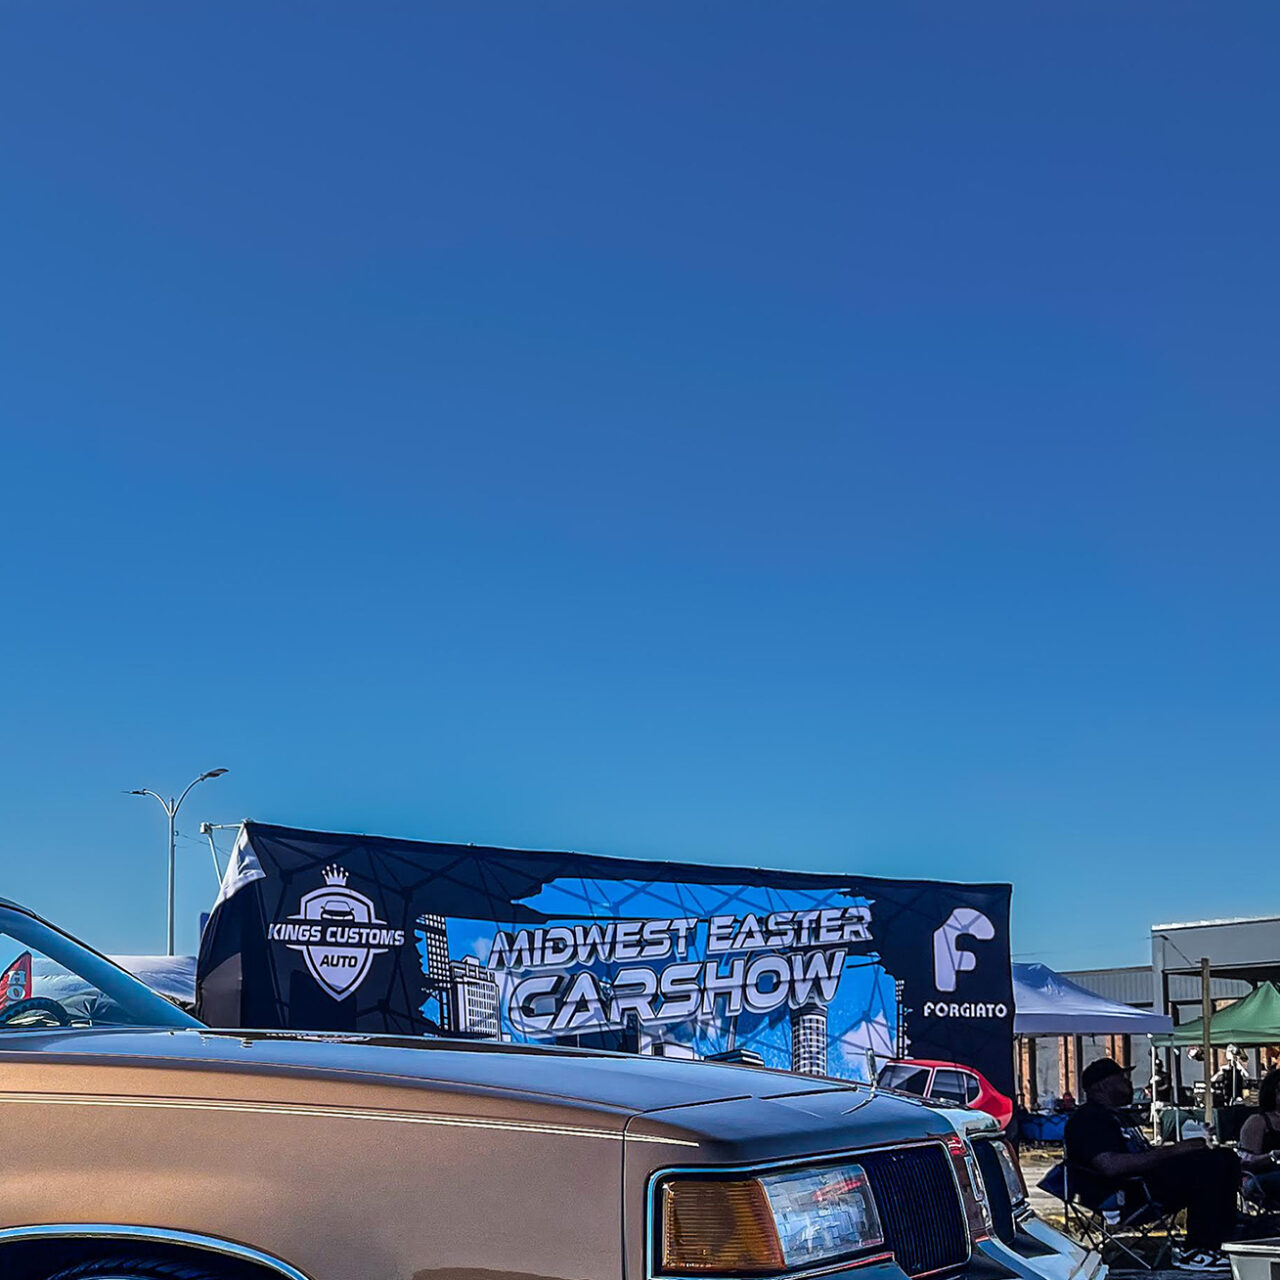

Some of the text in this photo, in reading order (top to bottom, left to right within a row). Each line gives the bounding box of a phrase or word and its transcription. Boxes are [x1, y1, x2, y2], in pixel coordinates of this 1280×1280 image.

[268, 923, 405, 946] KINGS CUSTOMS
[487, 906, 873, 970] MIDWEST EASTER
[320, 954, 358, 968] AUTO
[6, 970, 27, 1003] HO
[509, 948, 846, 1034] CARSHOW
[923, 1002, 1008, 1018] FORGIATO
